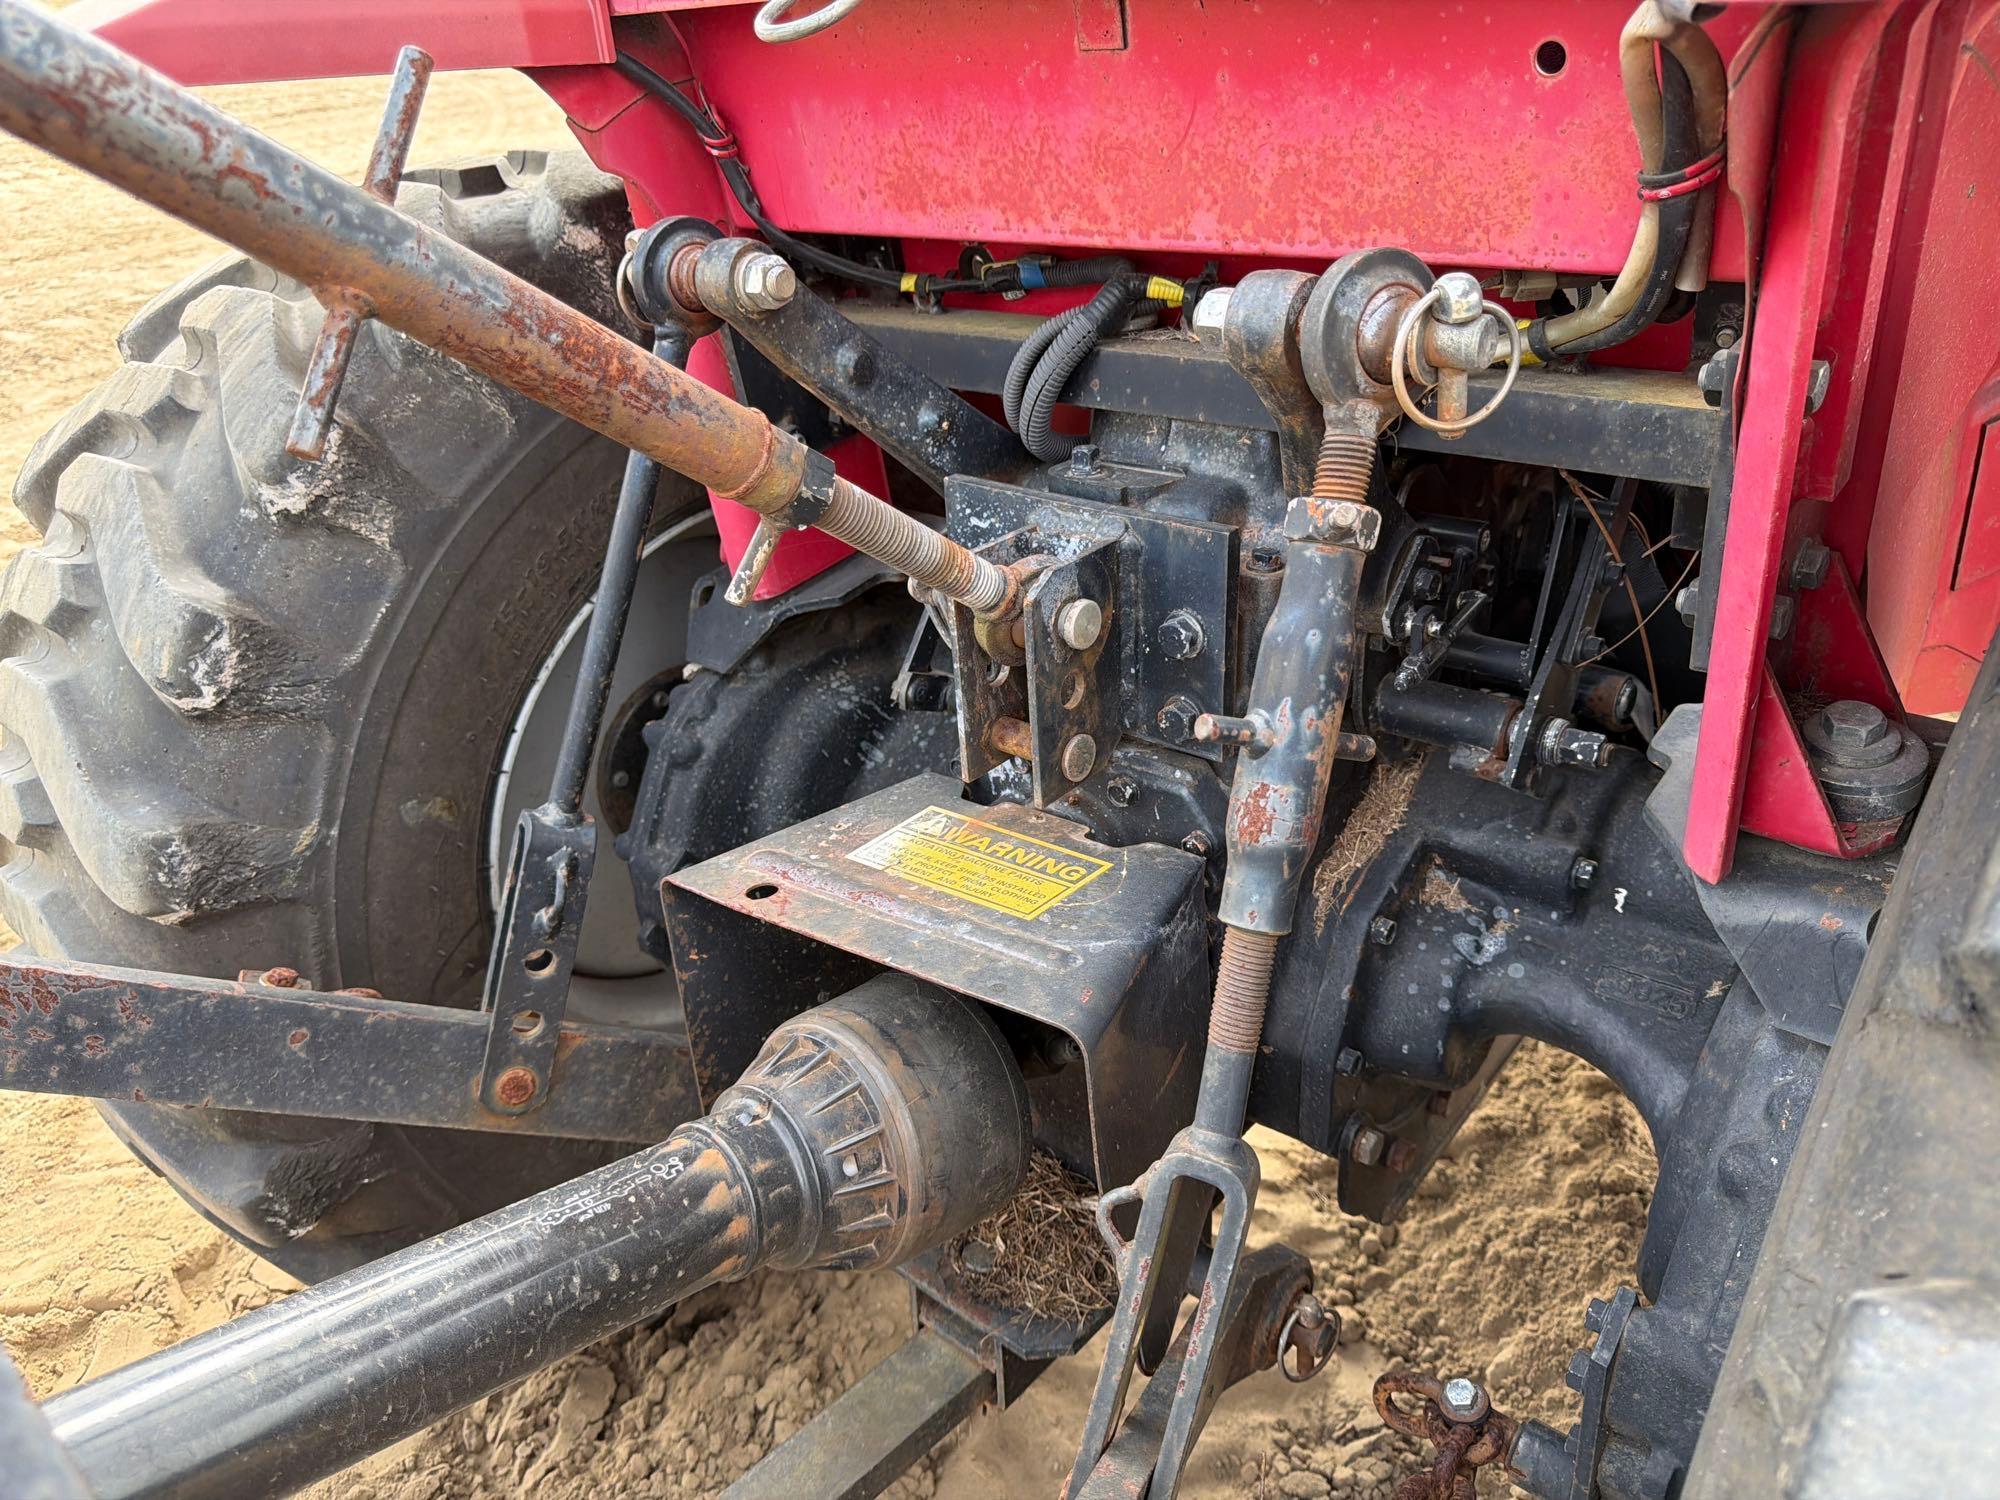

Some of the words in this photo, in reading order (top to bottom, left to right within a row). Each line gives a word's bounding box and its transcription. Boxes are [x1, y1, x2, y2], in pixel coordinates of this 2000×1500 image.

[909, 838, 958, 857] ROTATING
[958, 854, 1008, 873] MACHINE
[1008, 871, 1045, 886] PARTS
[943, 826, 1088, 881] WARNING
[914, 861, 955, 877] PROTECT
[959, 876, 987, 888] FROM
[989, 886, 1039, 905] CLOTHING
[933, 859, 958, 871] KEEP
[957, 866, 998, 883] SHIELDS
[996, 880, 1047, 899] INSTALLED
[936, 875, 958, 887] AND
